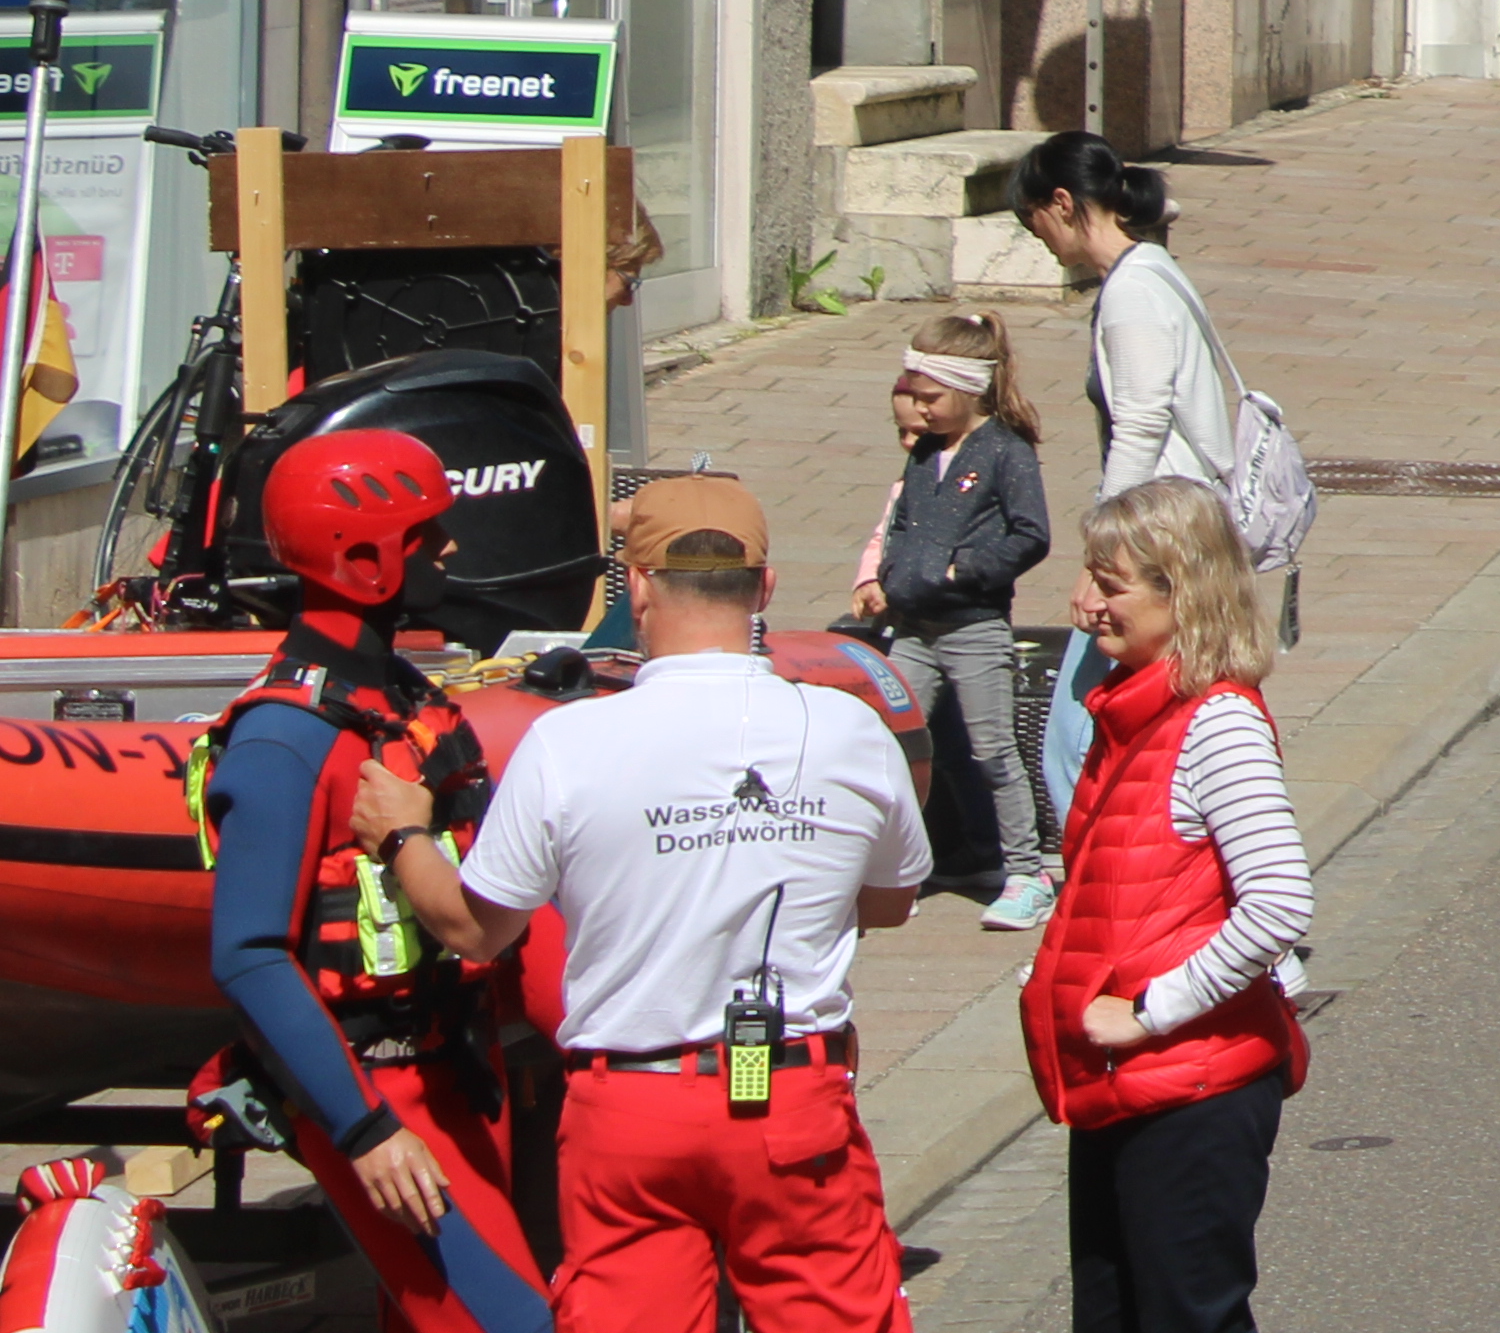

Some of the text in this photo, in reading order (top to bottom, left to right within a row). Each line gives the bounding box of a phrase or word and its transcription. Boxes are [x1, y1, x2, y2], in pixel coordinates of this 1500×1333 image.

[433, 67, 556, 99] freenet
[444, 459, 546, 496] CURY
[644, 796, 827, 828] Wassewacht
